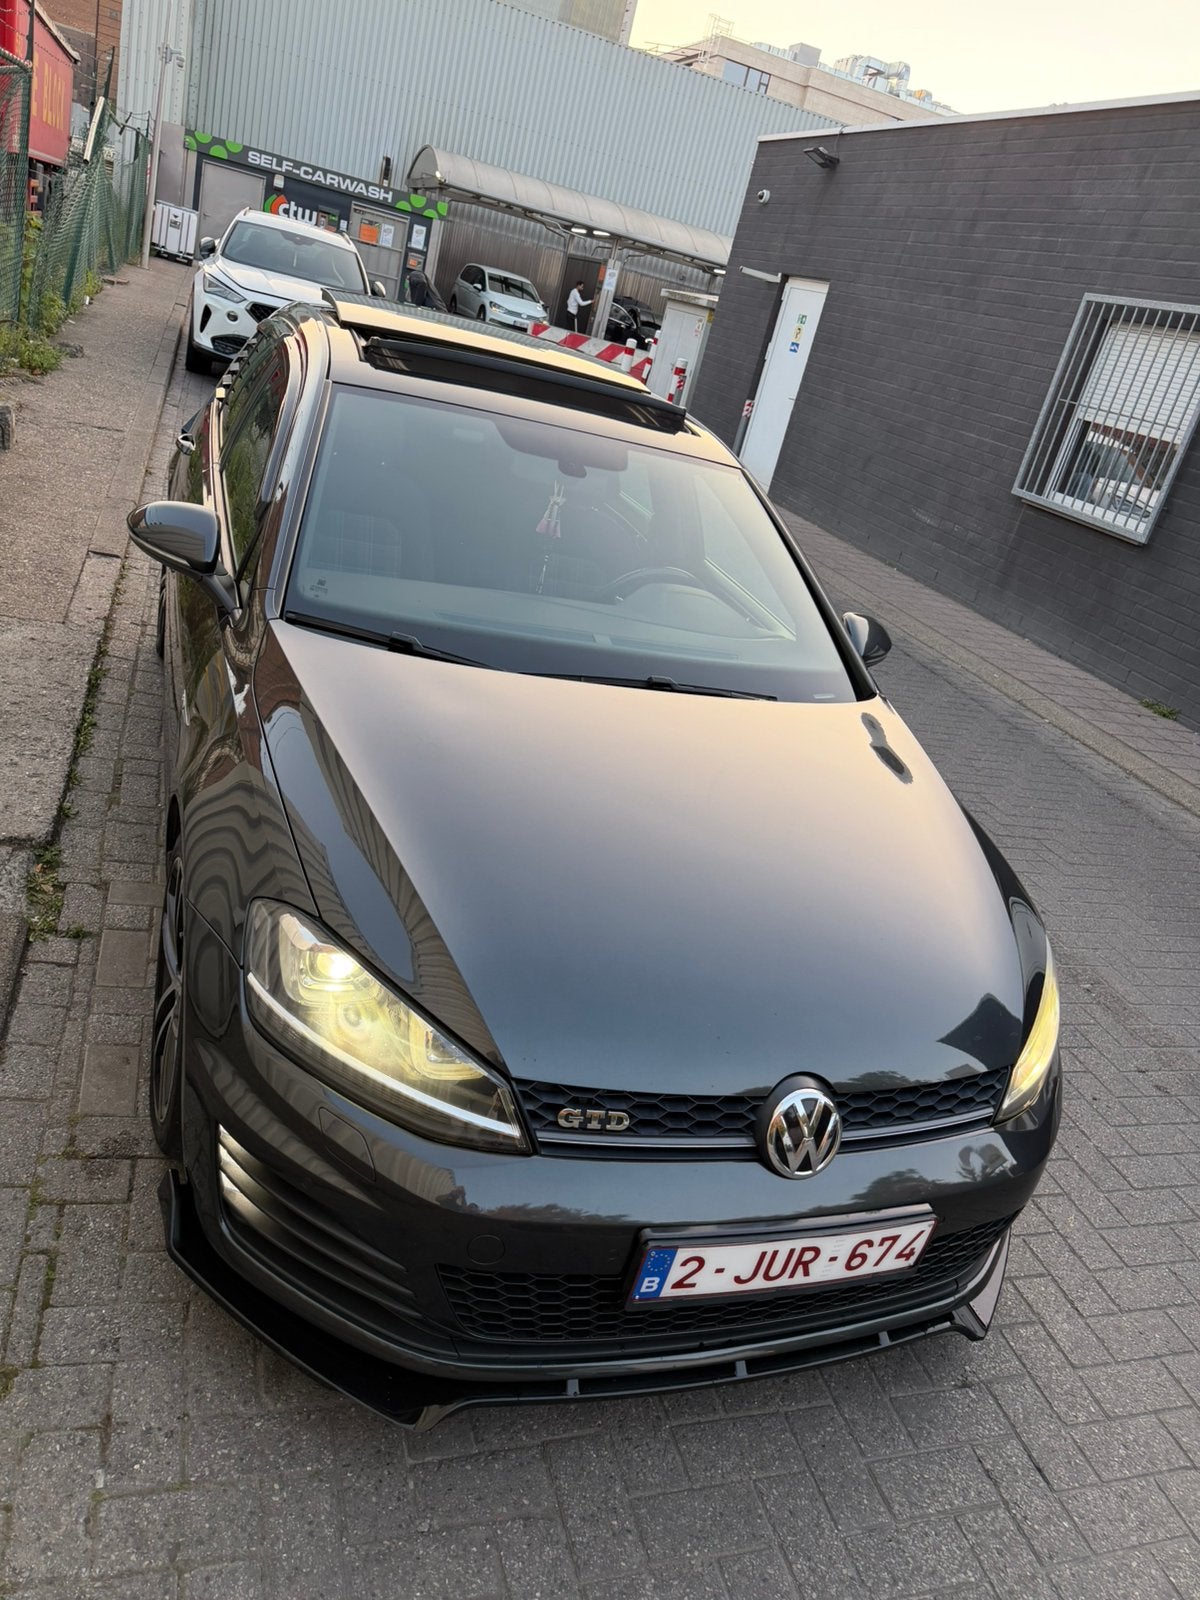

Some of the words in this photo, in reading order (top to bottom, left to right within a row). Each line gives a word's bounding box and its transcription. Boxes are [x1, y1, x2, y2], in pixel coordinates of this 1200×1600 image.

[247, 150, 393, 203] SELF-CARWASH
[278, 200, 318, 226] ctw
[557, 1107, 630, 1131] GTD
[640, 1277, 660, 1292] B
